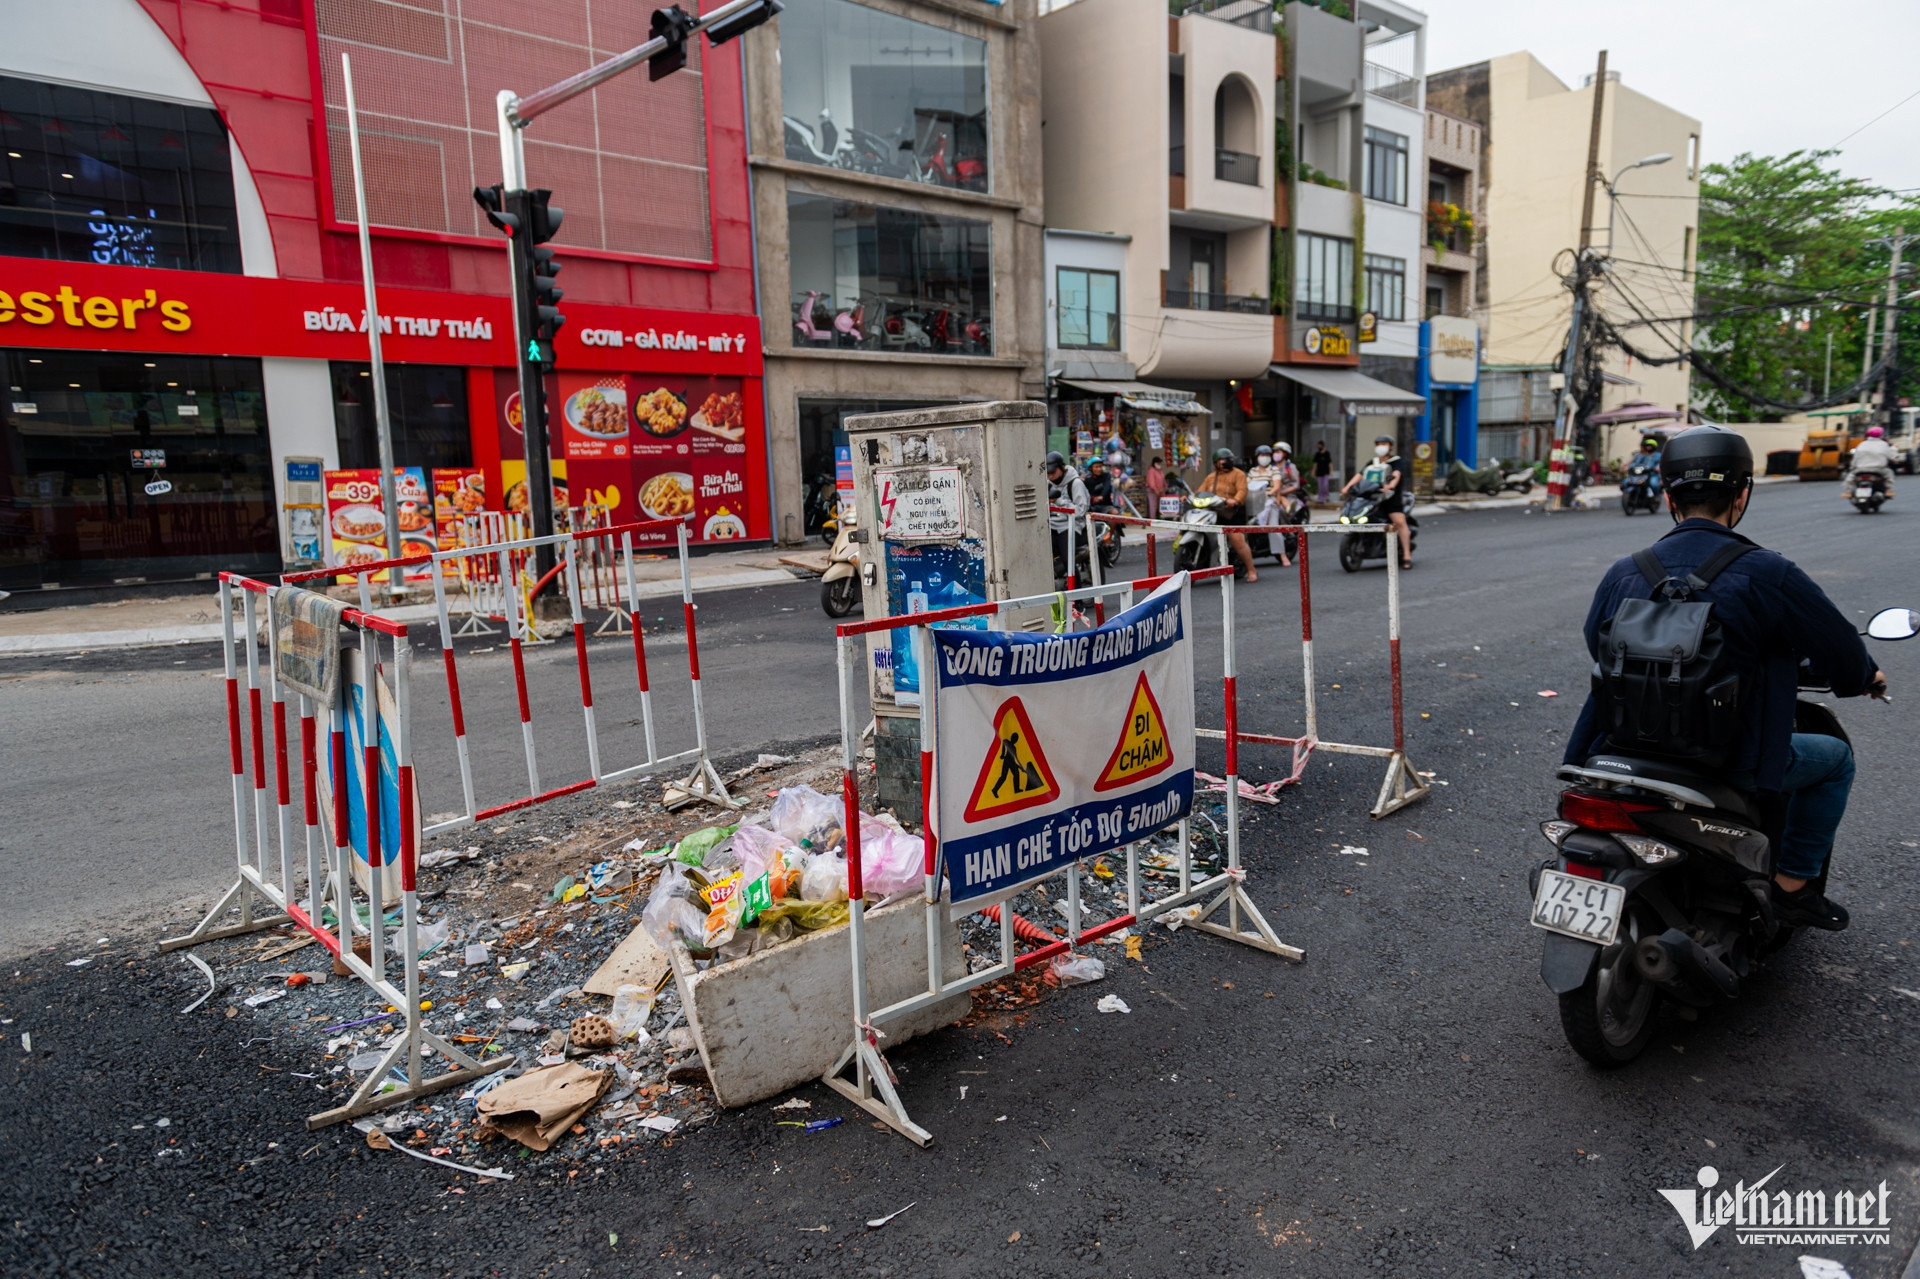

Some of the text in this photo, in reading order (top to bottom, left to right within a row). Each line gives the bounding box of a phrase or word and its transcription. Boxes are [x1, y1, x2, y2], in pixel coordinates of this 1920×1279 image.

[304, 306, 356, 332] BỮA
[394, 316, 441, 337] THƯ
[444, 316, 493, 340] THÁI
[581, 328, 623, 347] CƠM
[634, 328, 661, 349] GÀ
[662, 331, 698, 351] RÁN
[734, 333, 746, 353] Ý
[146, 482, 170, 493] OPEN
[1684, 468, 1704, 479] POC
[944, 602, 1179, 677] CÔNG TRƯỜNG ĐANG THI CÔNG
[1135, 711, 1150, 737] ĐI
[1119, 737, 1164, 773] CHẬM
[1596, 760, 1632, 771] HONDA
[964, 790, 1181, 888] HẠN CHẾ TỐC ĐỘ 5km/h
[1691, 818, 1748, 838] VISION
[1550, 876, 1609, 911] 72-C1
[1537, 900, 1613, 940] 407.22
